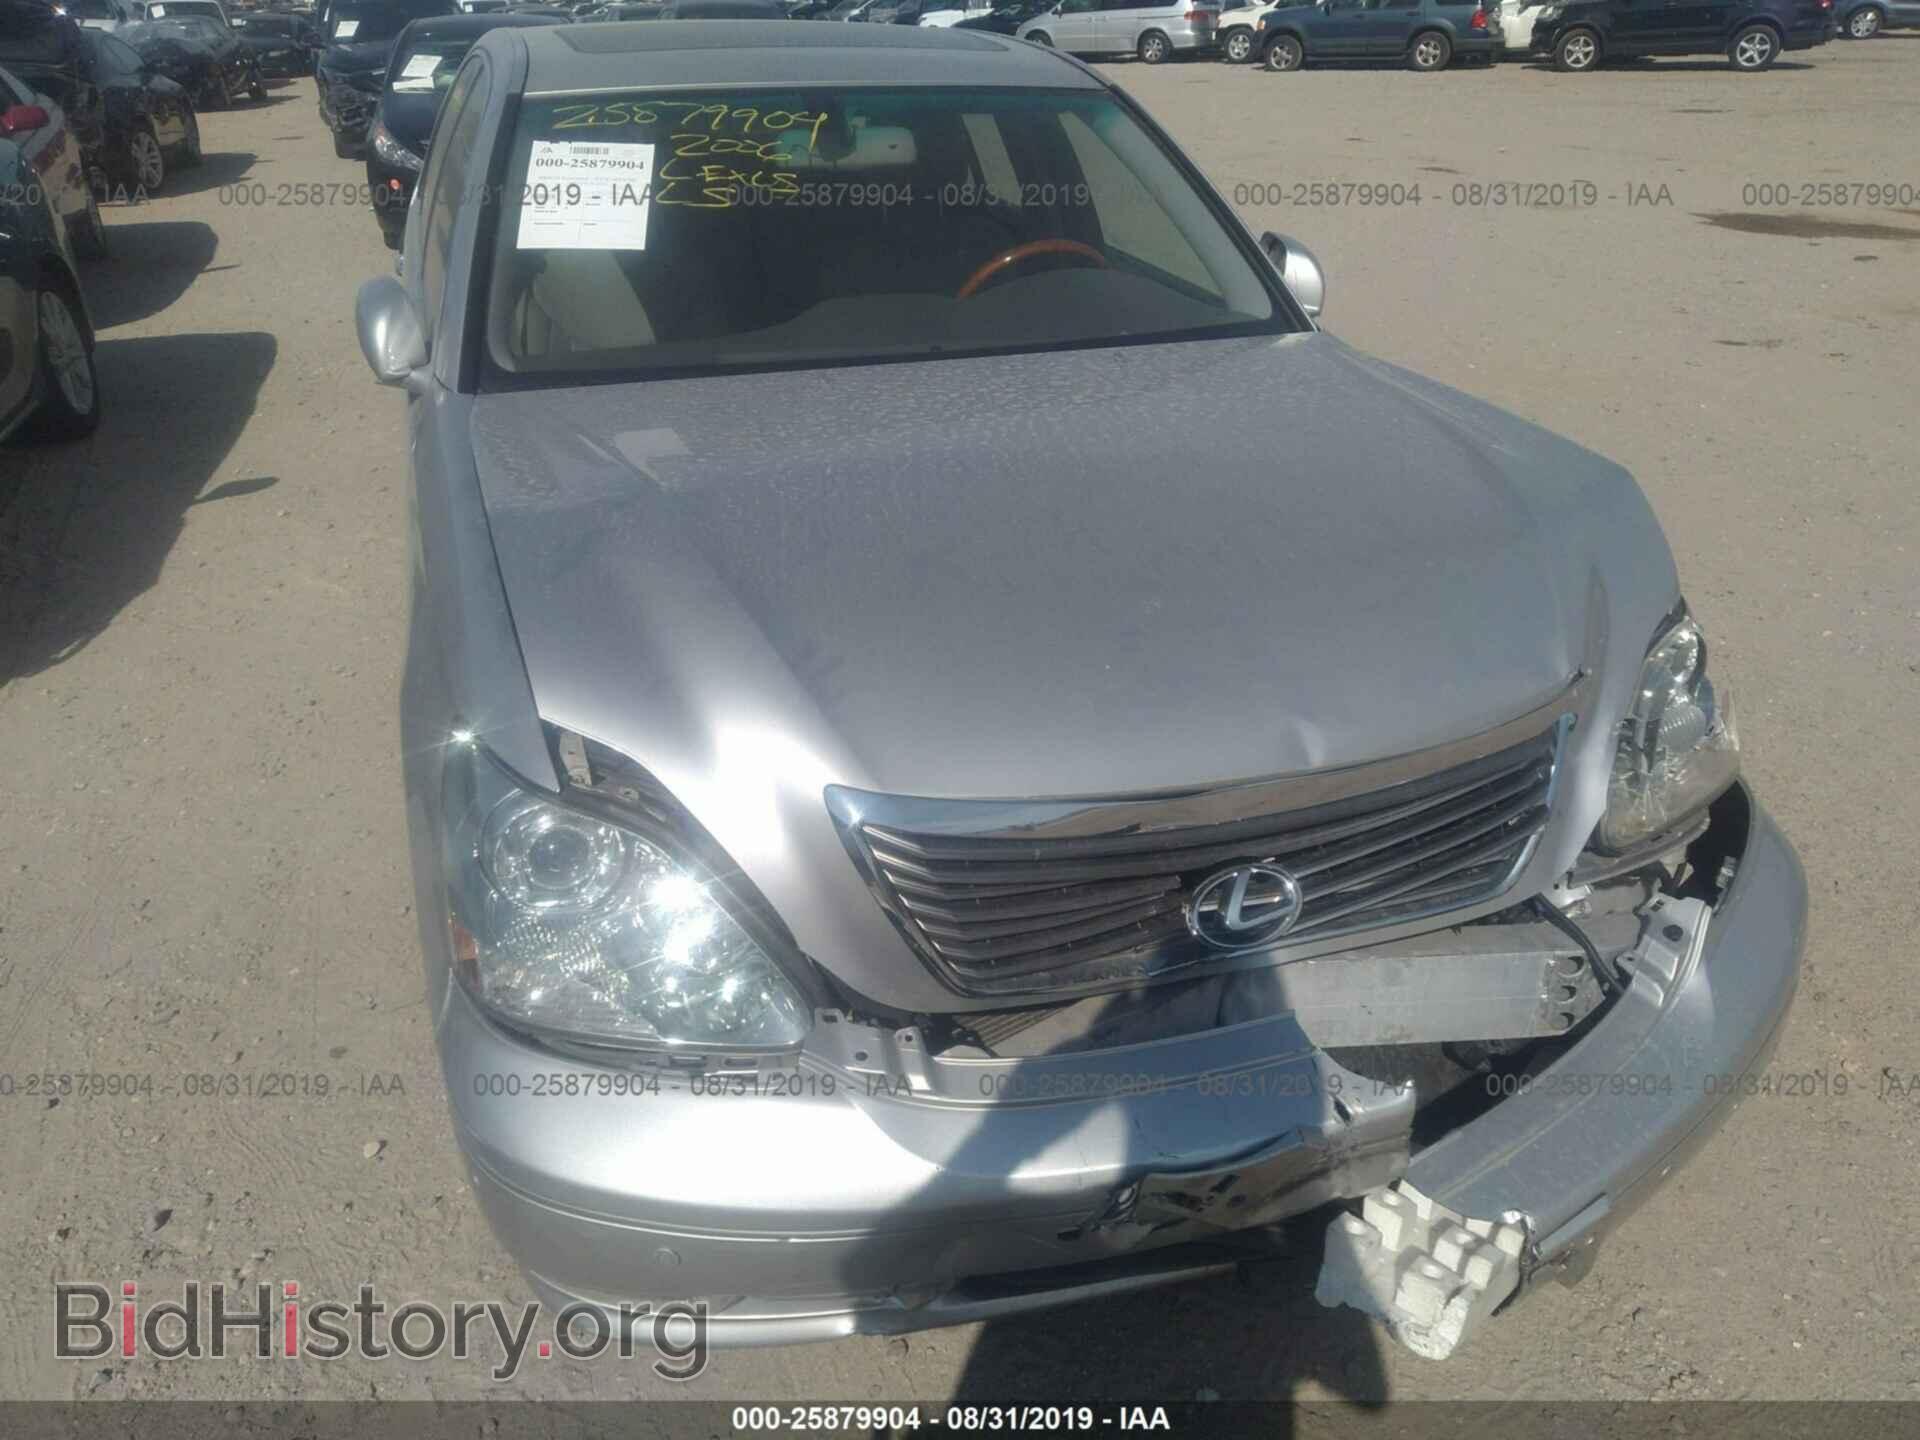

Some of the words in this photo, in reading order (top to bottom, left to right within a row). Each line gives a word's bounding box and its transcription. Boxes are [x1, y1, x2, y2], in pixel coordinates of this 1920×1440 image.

[552, 100, 828, 153] 25879904
[670, 134, 793, 161] 2006
[535, 157, 645, 170] 000-25879904
